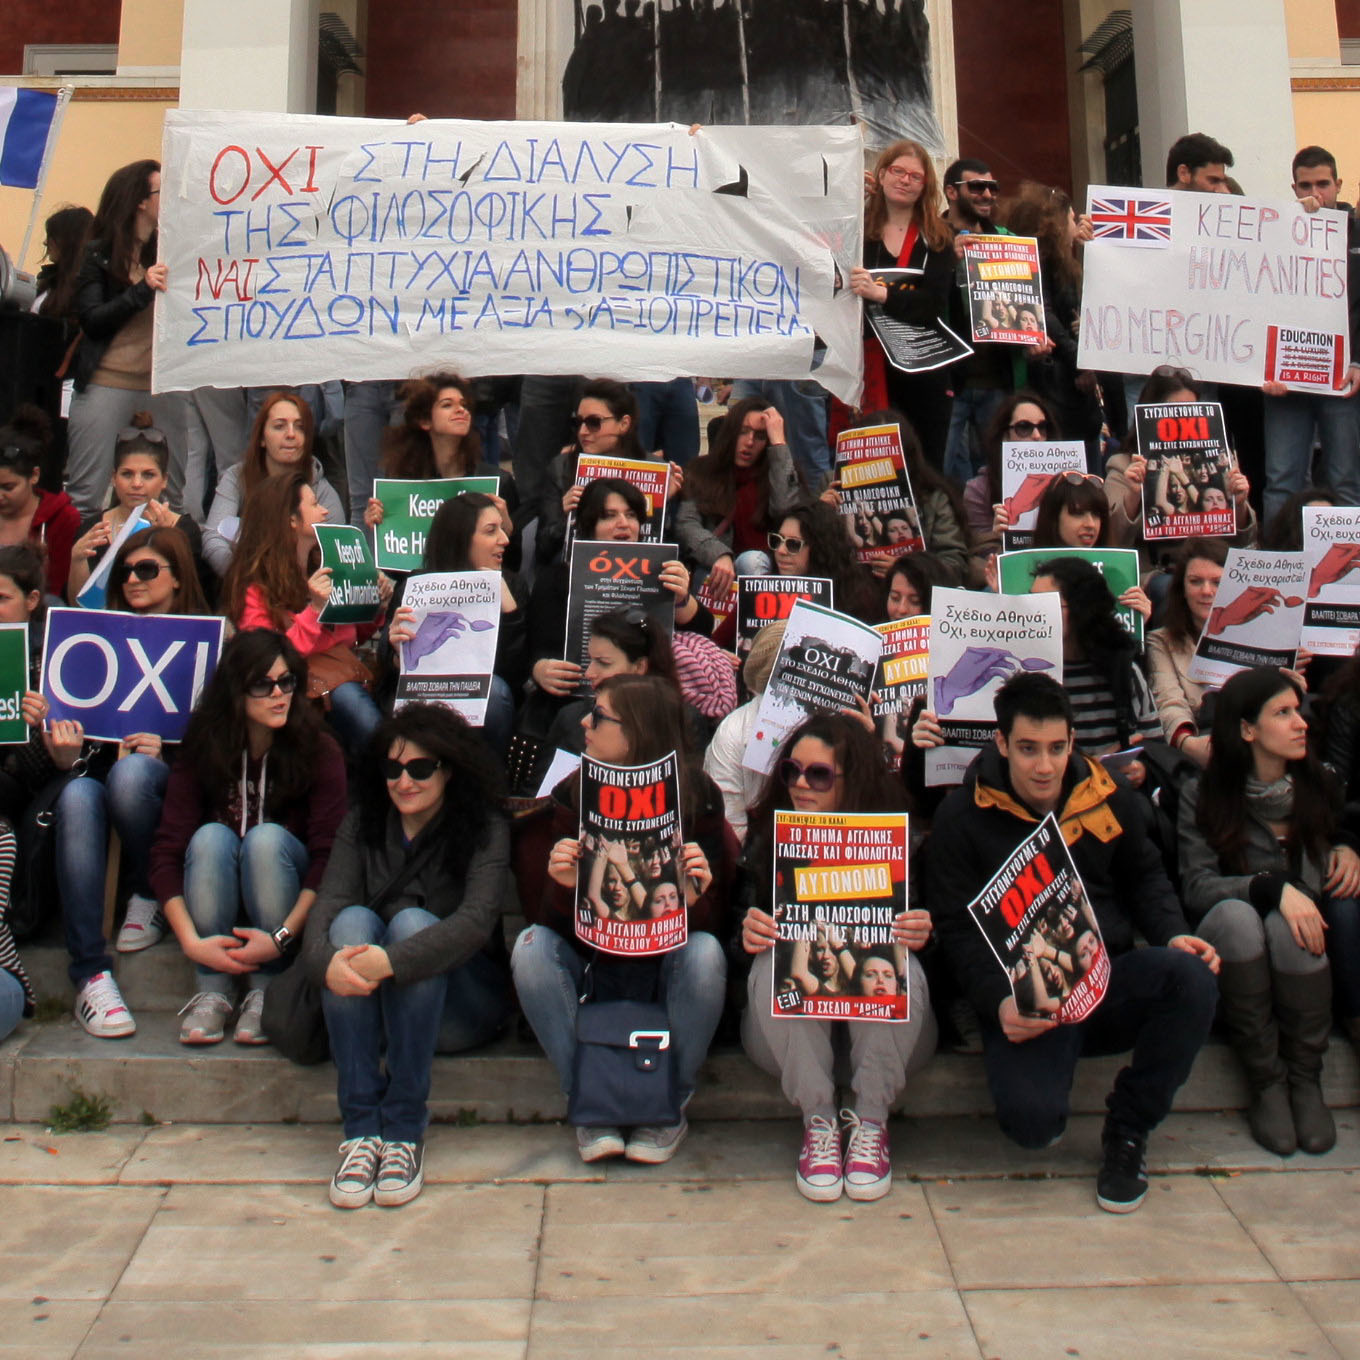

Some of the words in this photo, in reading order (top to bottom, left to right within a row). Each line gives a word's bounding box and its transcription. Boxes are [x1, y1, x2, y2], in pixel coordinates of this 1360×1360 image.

[209, 145, 324, 205] ΟΧΙ
[353, 141, 462, 182] ΣΤΗ
[484, 139, 699, 188] ΔΙΑΛΥΣΗ
[212, 202, 310, 254] ΤΗΣ
[331, 190, 612, 247] ΦΙΛΟΣΟΦΙΚΗΣ
[1198, 203, 1279, 242] KEEP
[1292, 215, 1338, 250] OFF
[195, 257, 259, 301] ΝΑΙ
[258, 251, 336, 294] ΣΤΑ
[346, 251, 498, 294] ΠΤΥΧΙΑ
[1188, 245, 1346, 299] HUMANITIES
[187, 294, 399, 346] ΣΠΟΥΔΩΝ
[417, 291, 471, 332] ΜΕ
[474, 293, 554, 330] ΑΞΙΑ
[1084, 305, 1123, 350] NO
[1128, 307, 1254, 364] MERGING
[1281, 329, 1333, 347] EDUCATION
[1304, 373, 1328, 382] RIGHT
[1144, 406, 1203, 419] ΣΥΓΧΩΝΕΥΟΥΜΕ
[1206, 406, 1215, 416] ΤΟ
[1157, 417, 1211, 442] ΟΧΙ
[1011, 448, 1044, 460] Σχέδιο
[1046, 448, 1078, 460] Αθηνά;
[842, 461, 895, 484] ΑΥΤΟΝΟΜΟ
[1315, 514, 1353, 526] Σχέδιο
[384, 530, 408, 554] the
[334, 539, 354, 570] Keep
[354, 539, 365, 563] off
[589, 550, 651, 579] όχι
[1237, 557, 1272, 570] Σχέδιο
[1274, 562, 1304, 574] Αθηνά;
[411, 582, 447, 595] Σχέδιο
[449, 579, 491, 593] Αθηνά;
[745, 580, 809, 593] ΣΥΓΧΩΝΕΥΟΥΜΕ
[813, 582, 822, 594] ΤΟ
[946, 605, 992, 623] Σχέδιο
[996, 611, 1047, 627] Αθηνά;
[890, 631, 919, 644] ΤΜΗΜΑ
[903, 641, 917, 652] ΚΑΙ
[804, 648, 841, 671] ΟΧΙ
[48, 632, 210, 714] ΟΧΙ
[588, 762, 663, 787] ΣΥΓΧΩΝΕΥΟΥΜΕ
[664, 760, 672, 777] ΤΟ
[598, 782, 666, 821] ΟΧΙ
[589, 810, 601, 826] ΜΑΣ
[604, 819, 623, 831] ΣΤΙΣ
[626, 810, 675, 832] ΣΥΓΧΩΝΕΥΣΕΙΣ
[660, 826, 675, 841] ΤΟΥΣ
[790, 828, 802, 842] ΤΟ
[806, 828, 843, 843] ΤΜΗΜΑ
[847, 830, 893, 844] ΑΓΓΛΙΚΗΣ
[778, 843, 819, 859] ΓΛΩΣΣΑΣ
[823, 845, 841, 859] ΚΑΙ
[845, 845, 903, 860] ΦΙΛΟΛΟΓΙΑΣ
[798, 867, 888, 895] ΑΥΤΟΝΟΜΟ
[980, 841, 1039, 915] ΣΥΓΧΩΝΕΥΟΥΜΕ
[1037, 828, 1051, 849] ΤΟ
[999, 852, 1055, 929] ΟΧΙ
[786, 904, 809, 921] ΣΤΗ
[815, 903, 893, 924] ΦΙΛΟΣΟΦΙΚΗ
